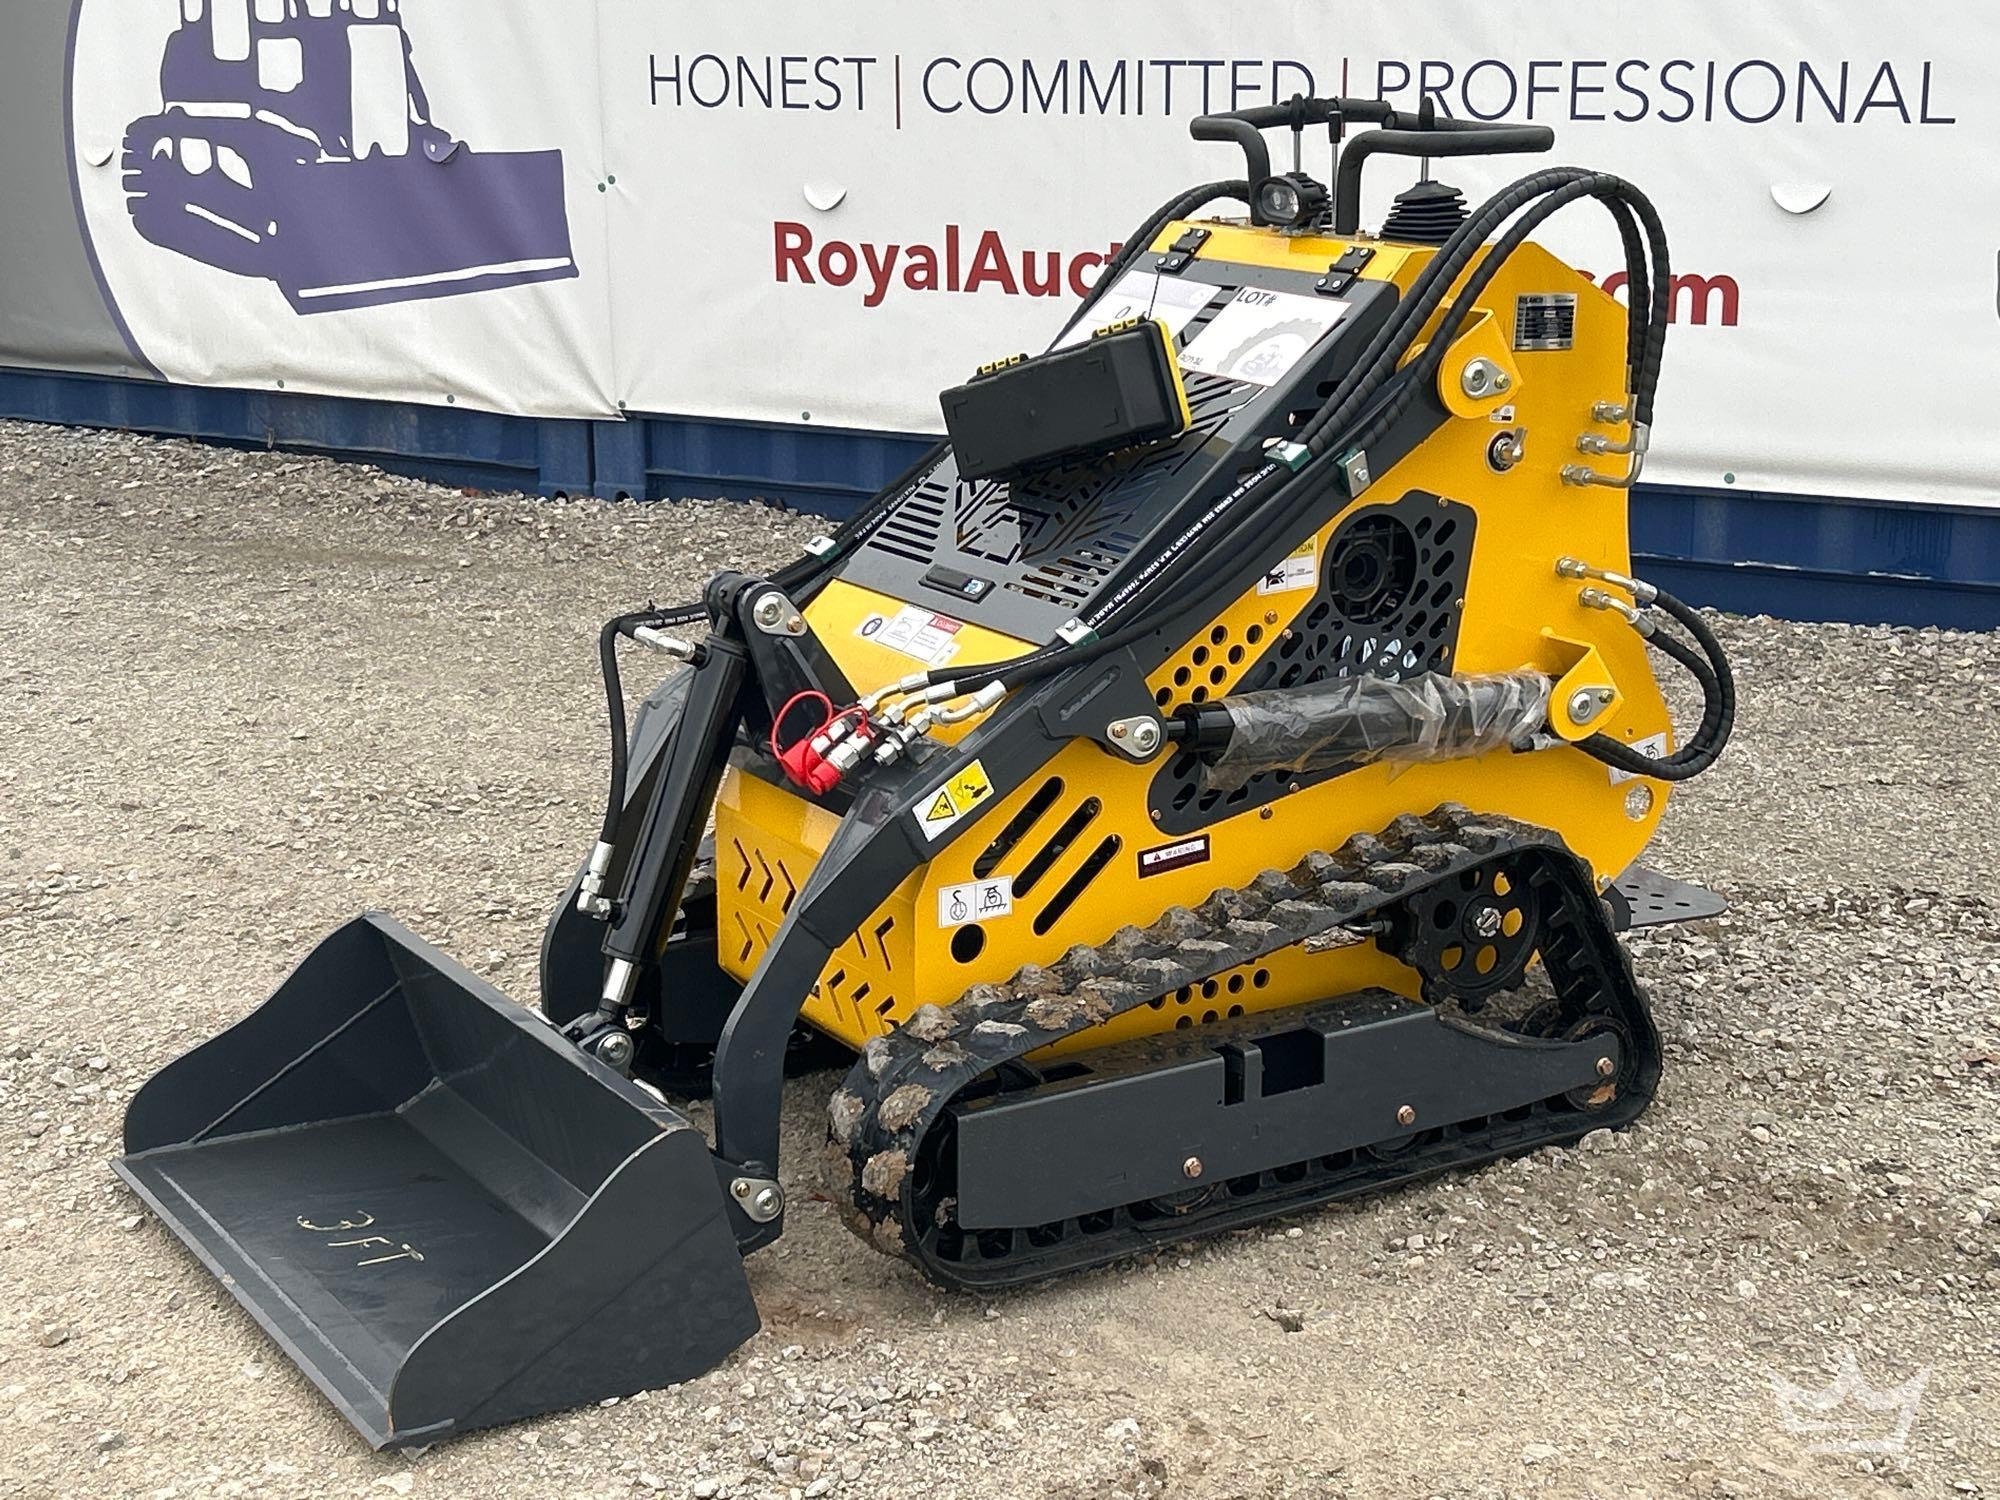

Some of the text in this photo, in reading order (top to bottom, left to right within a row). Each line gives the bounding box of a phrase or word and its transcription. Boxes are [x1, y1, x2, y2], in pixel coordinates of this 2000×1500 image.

[650, 54, 1956, 125] HONEST COMMITTED PROFESSIONAL
[1236, 291, 1277, 307] LOT#
